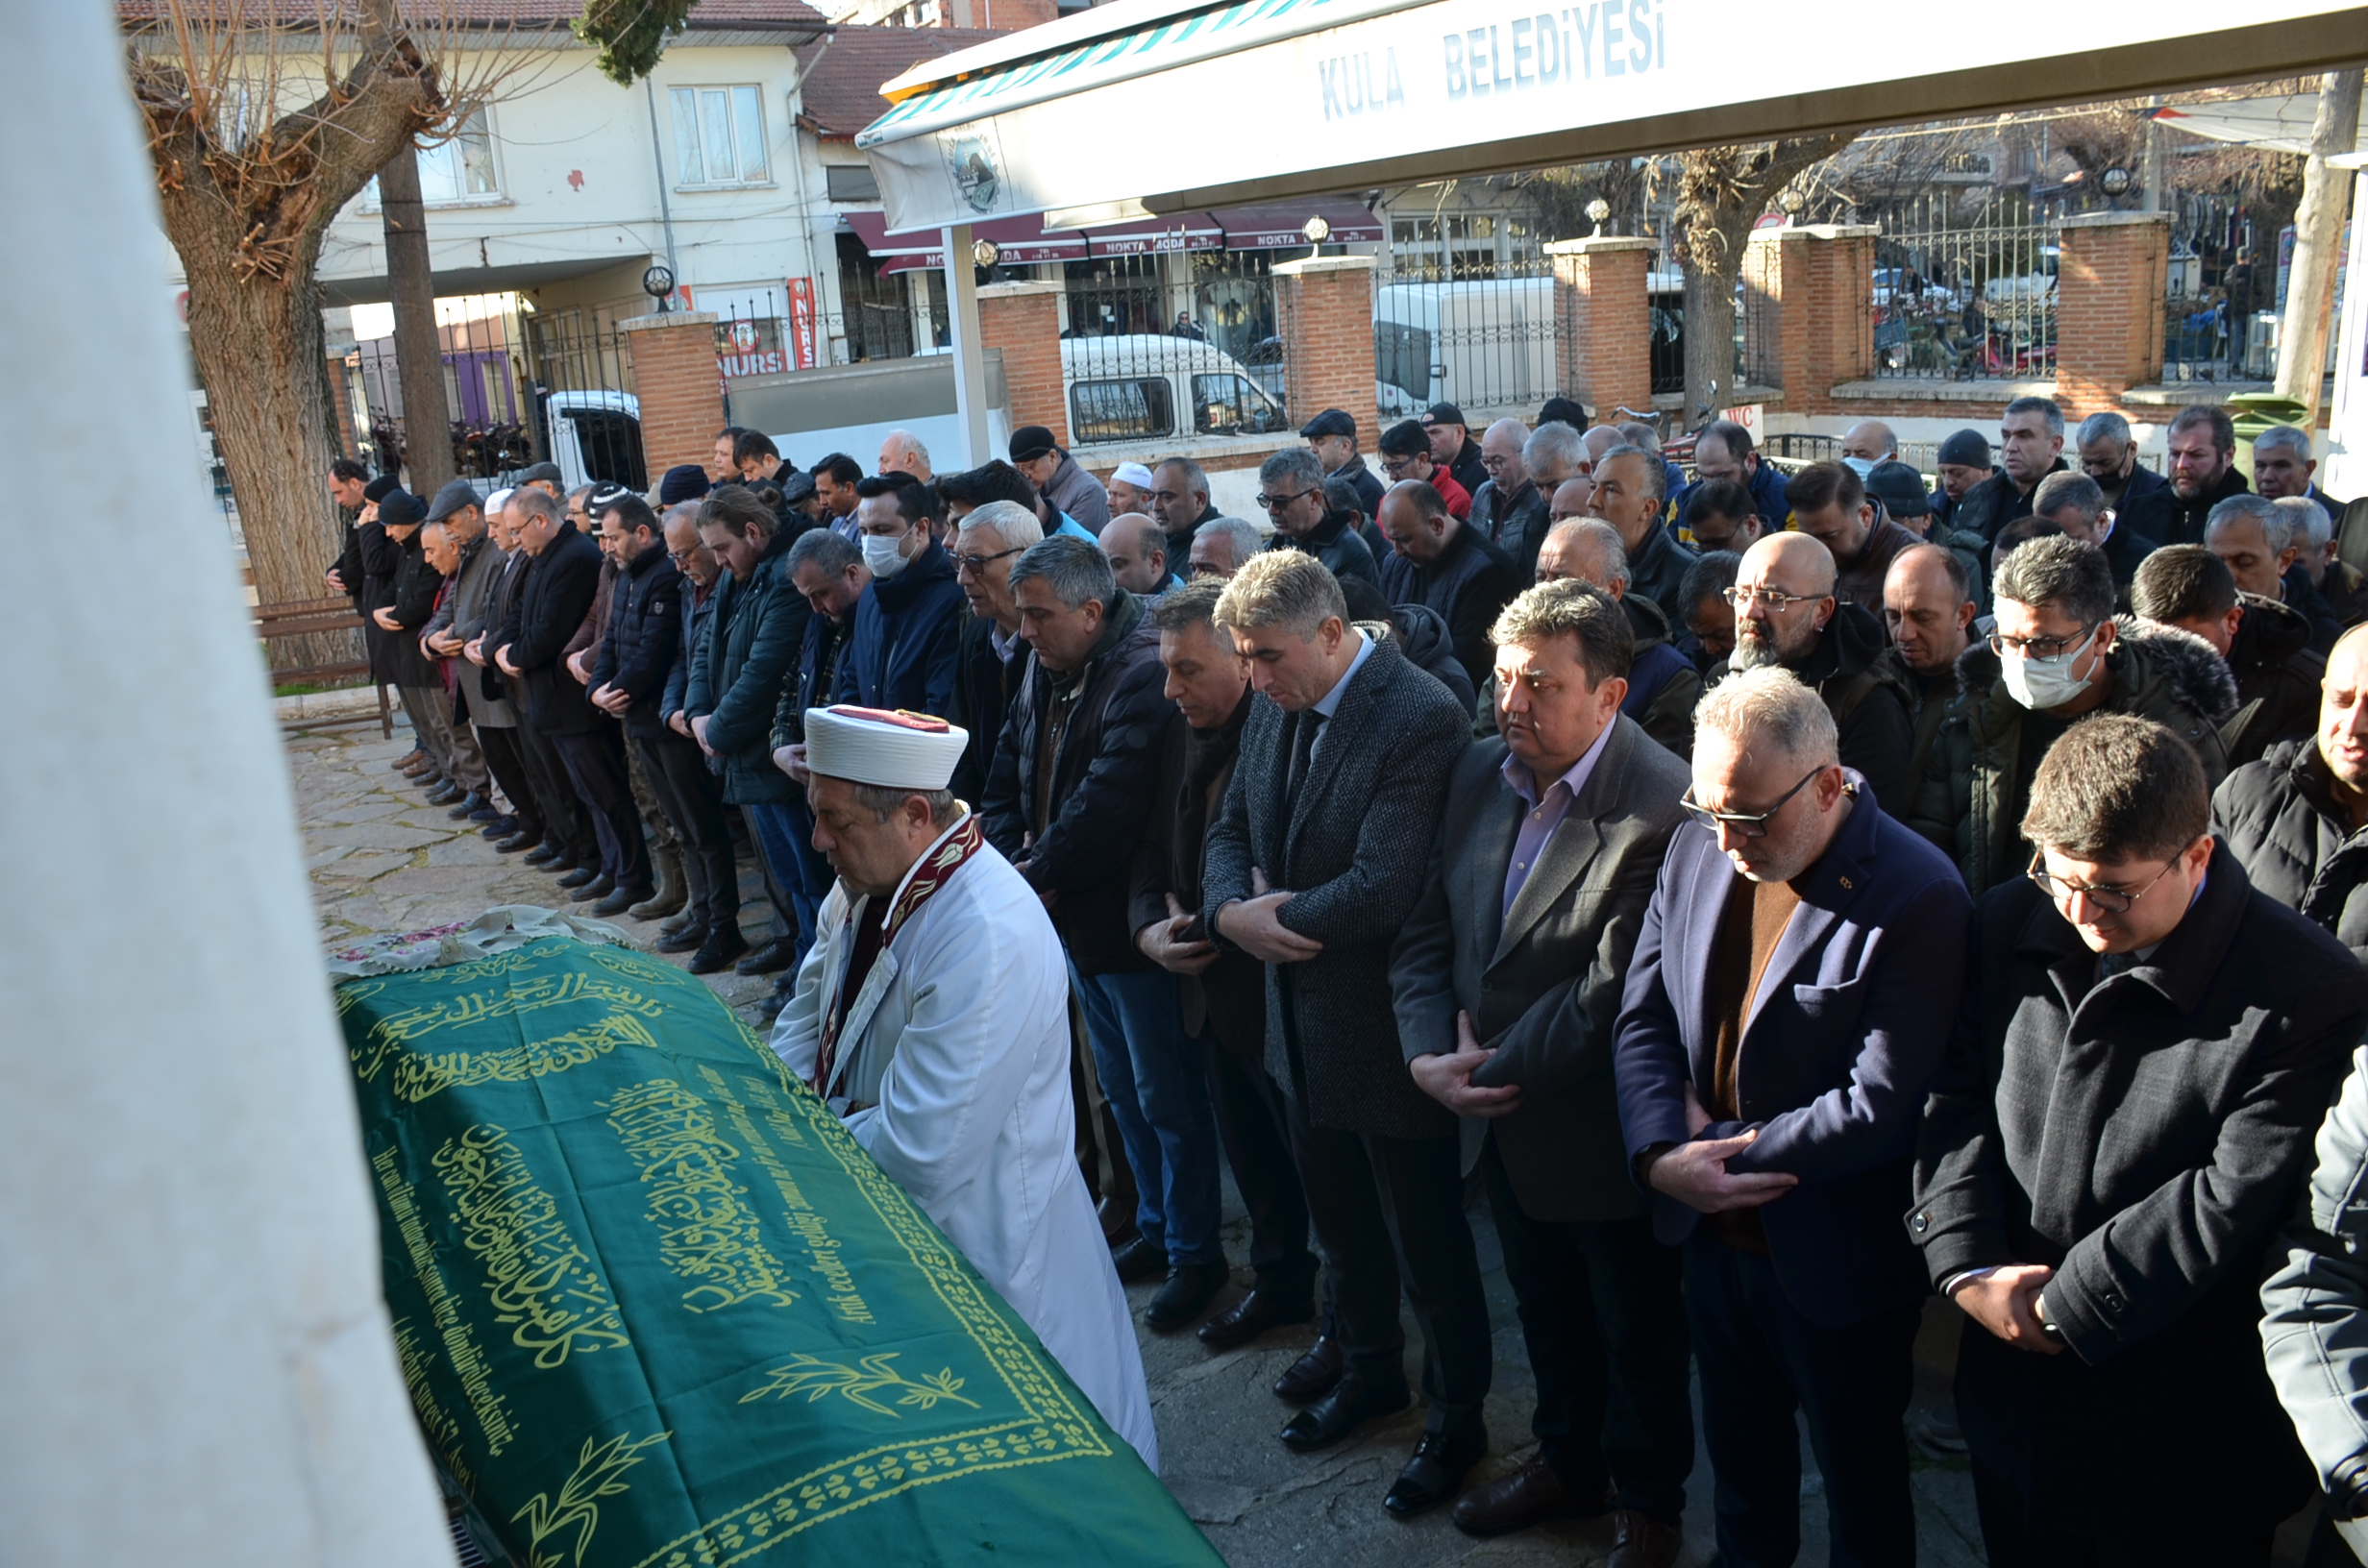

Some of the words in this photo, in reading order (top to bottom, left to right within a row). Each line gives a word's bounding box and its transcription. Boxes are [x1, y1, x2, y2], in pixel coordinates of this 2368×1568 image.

[1319, 46, 1406, 123] KULA
[1106, 240, 1146, 254] NOKTA
[1156, 238, 1185, 251] MODA
[1257, 235, 1295, 246] NOKTA
[795, 299, 814, 362] NURS
[717, 352, 783, 378] NURS
[1727, 405, 1754, 428] WC
[372, 1144, 398, 1173] Her
[381, 1168, 402, 1191] can
[432, 1293, 463, 1330] bize
